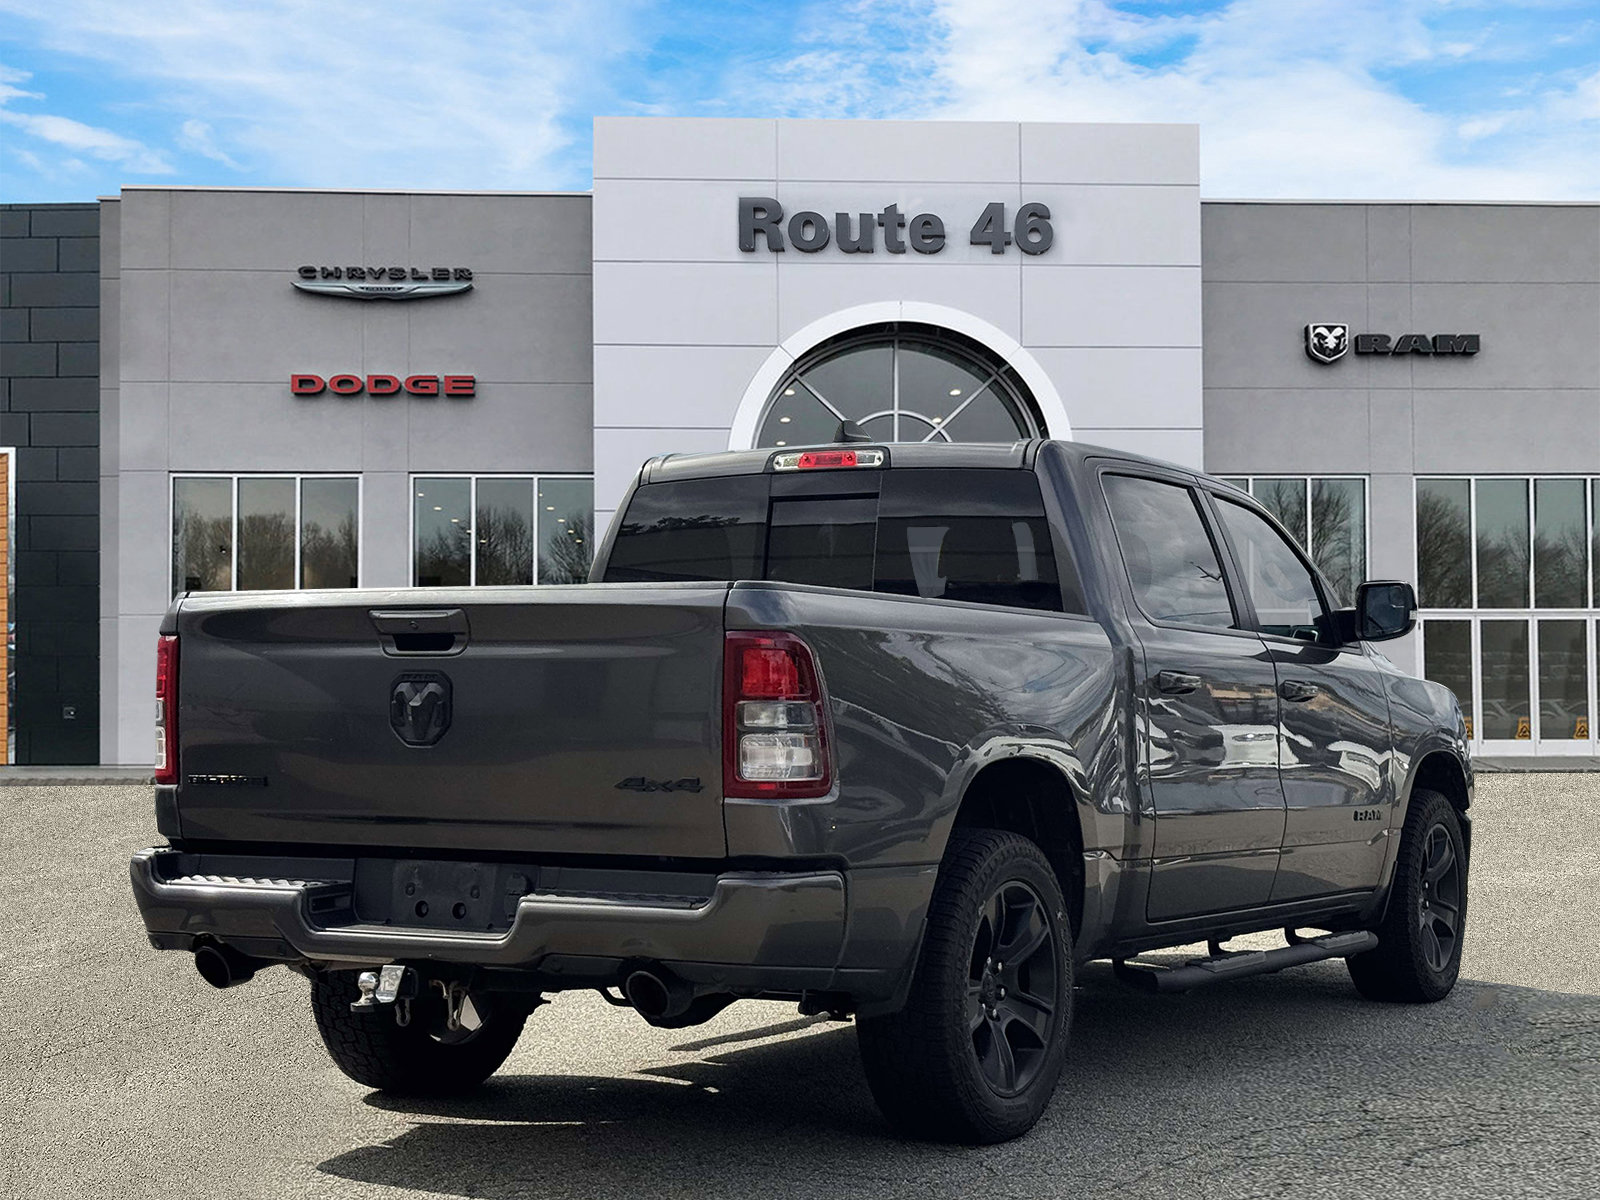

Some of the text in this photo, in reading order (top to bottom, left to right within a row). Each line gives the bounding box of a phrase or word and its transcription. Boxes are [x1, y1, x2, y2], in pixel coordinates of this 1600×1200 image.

[738, 197, 1054, 256] Route 46
[298, 266, 473, 280] CHRYSLER
[1355, 334, 1480, 355] RAM
[291, 374, 476, 397] DODGE
[1353, 810, 1381, 821] RAM
